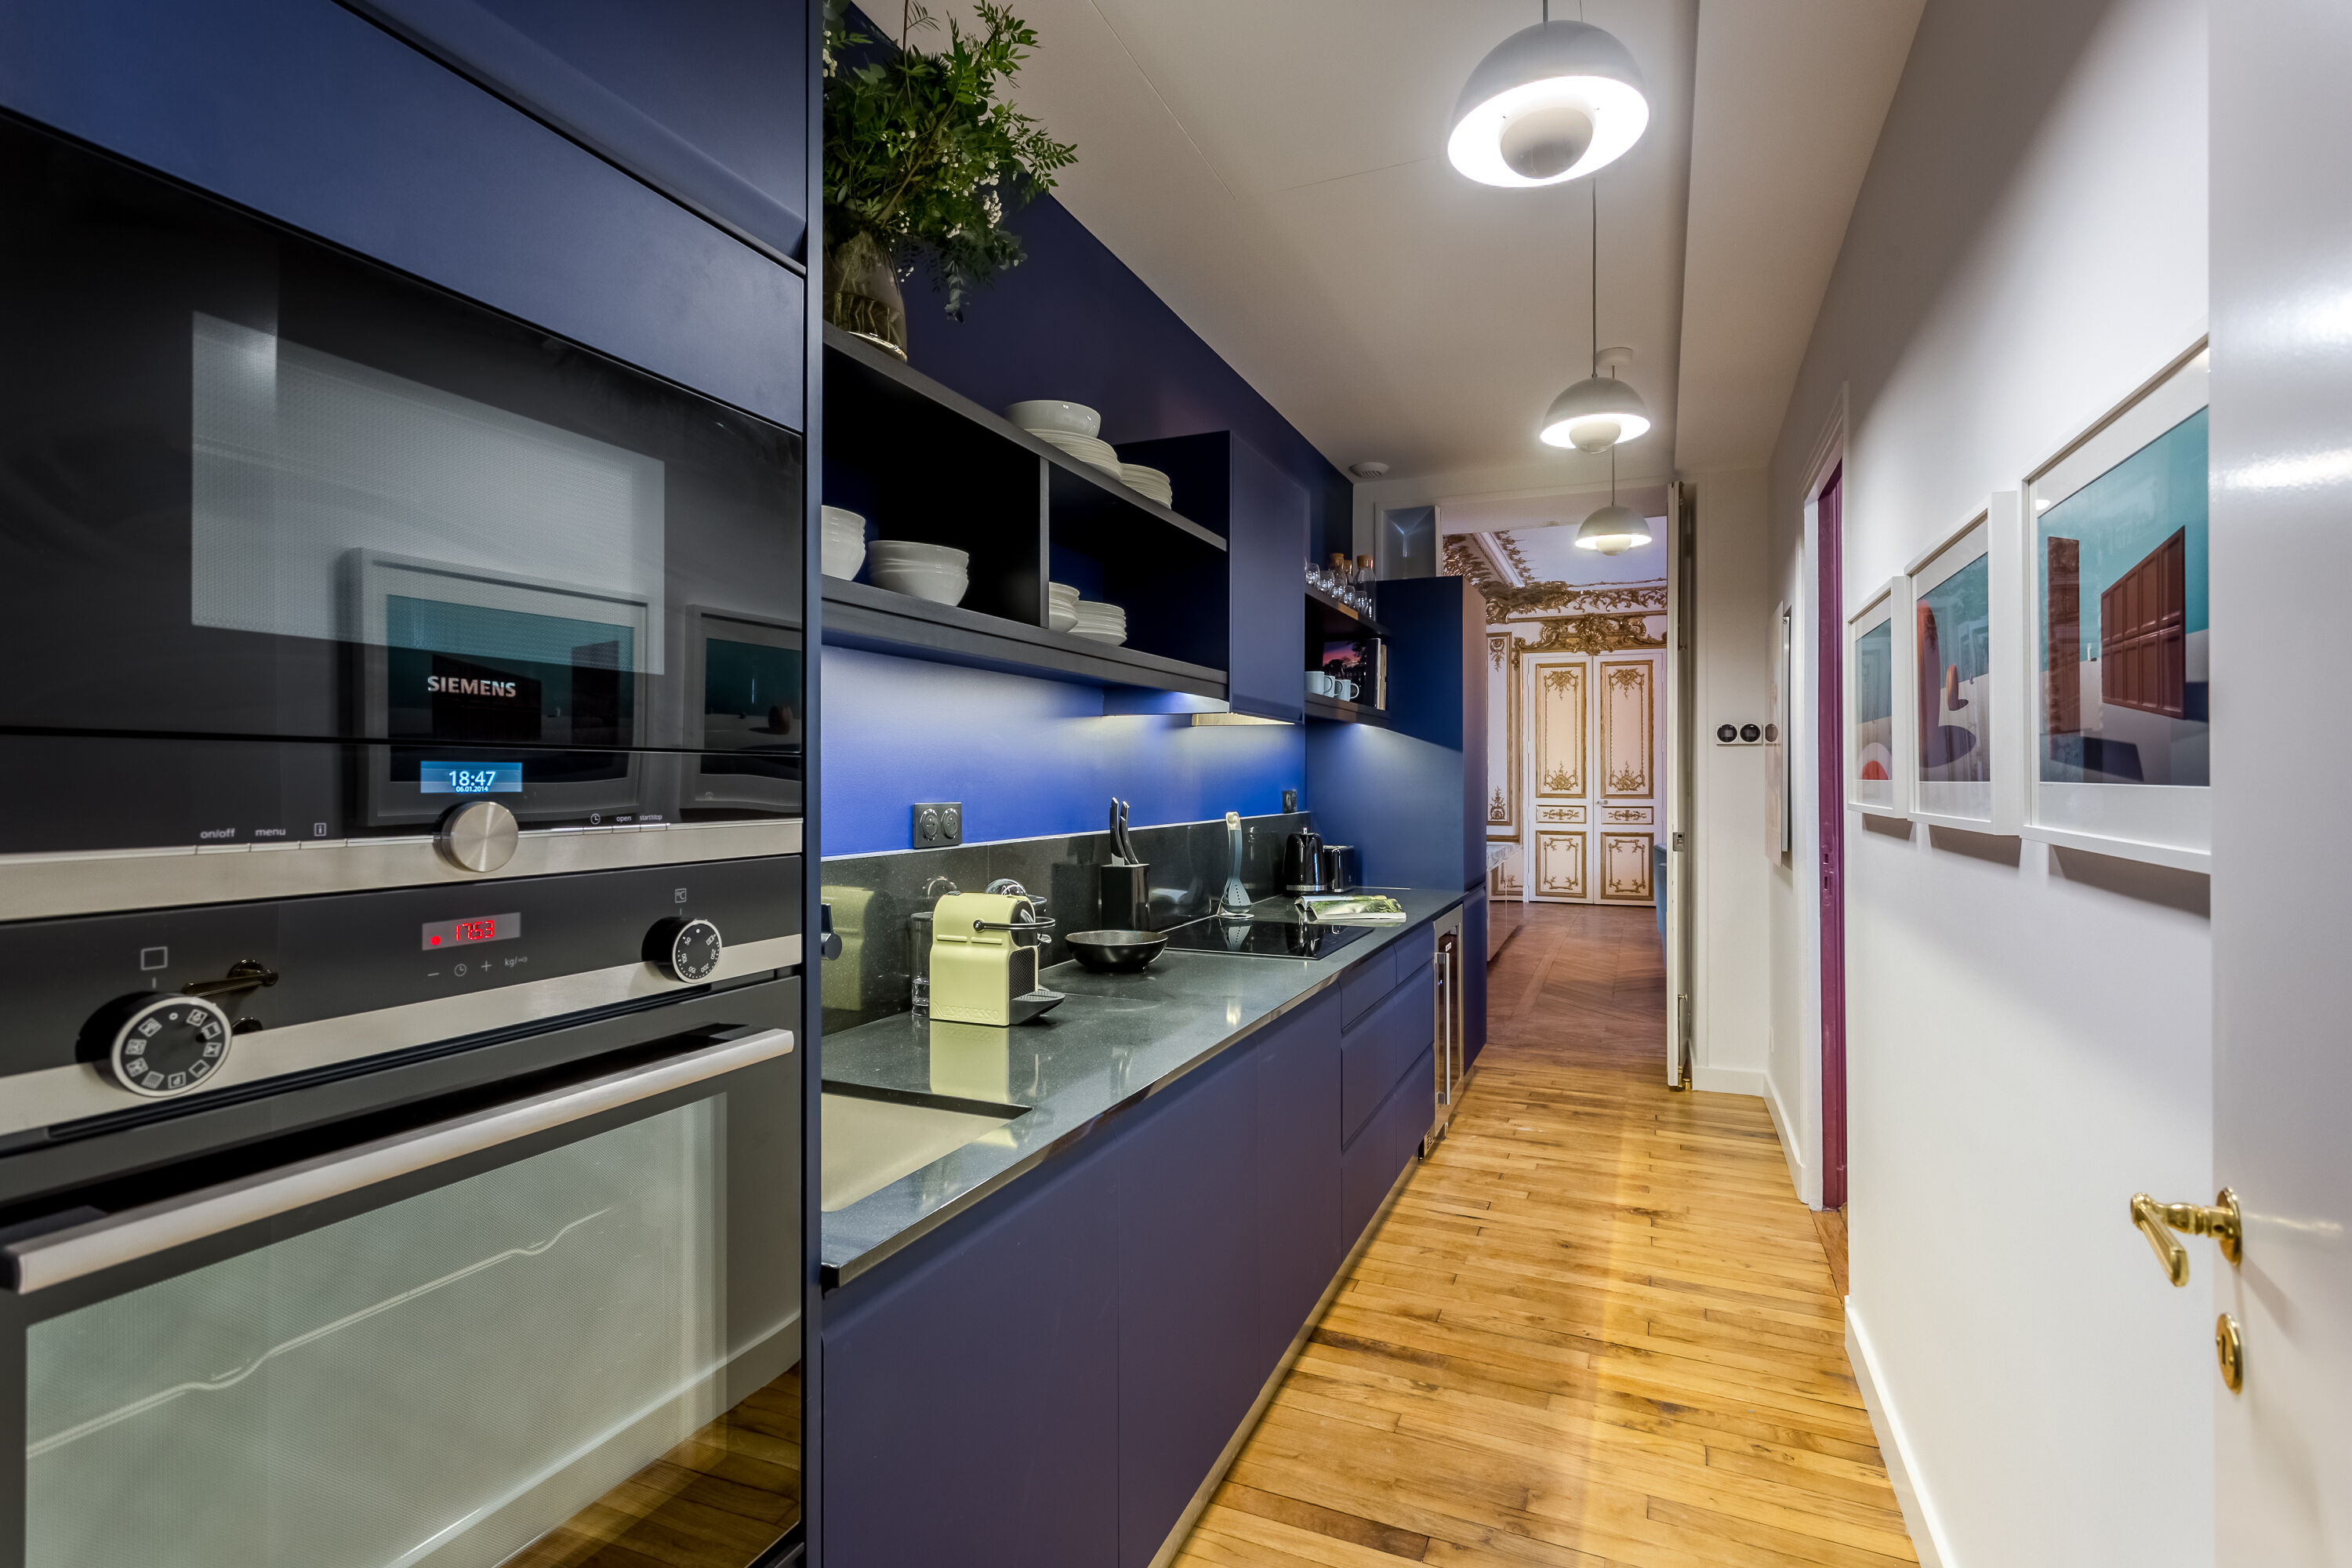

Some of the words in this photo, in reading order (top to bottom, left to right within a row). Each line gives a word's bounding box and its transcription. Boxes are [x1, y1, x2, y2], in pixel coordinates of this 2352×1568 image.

[427, 676, 516, 697] SIEMENS
[448, 770, 496, 786] 18:47
[200, 828, 236, 840] on/off
[456, 920, 495, 942] 17:53
[684, 937, 691, 946] 50
[932, 1001, 1000, 1021] NESPRESSO
